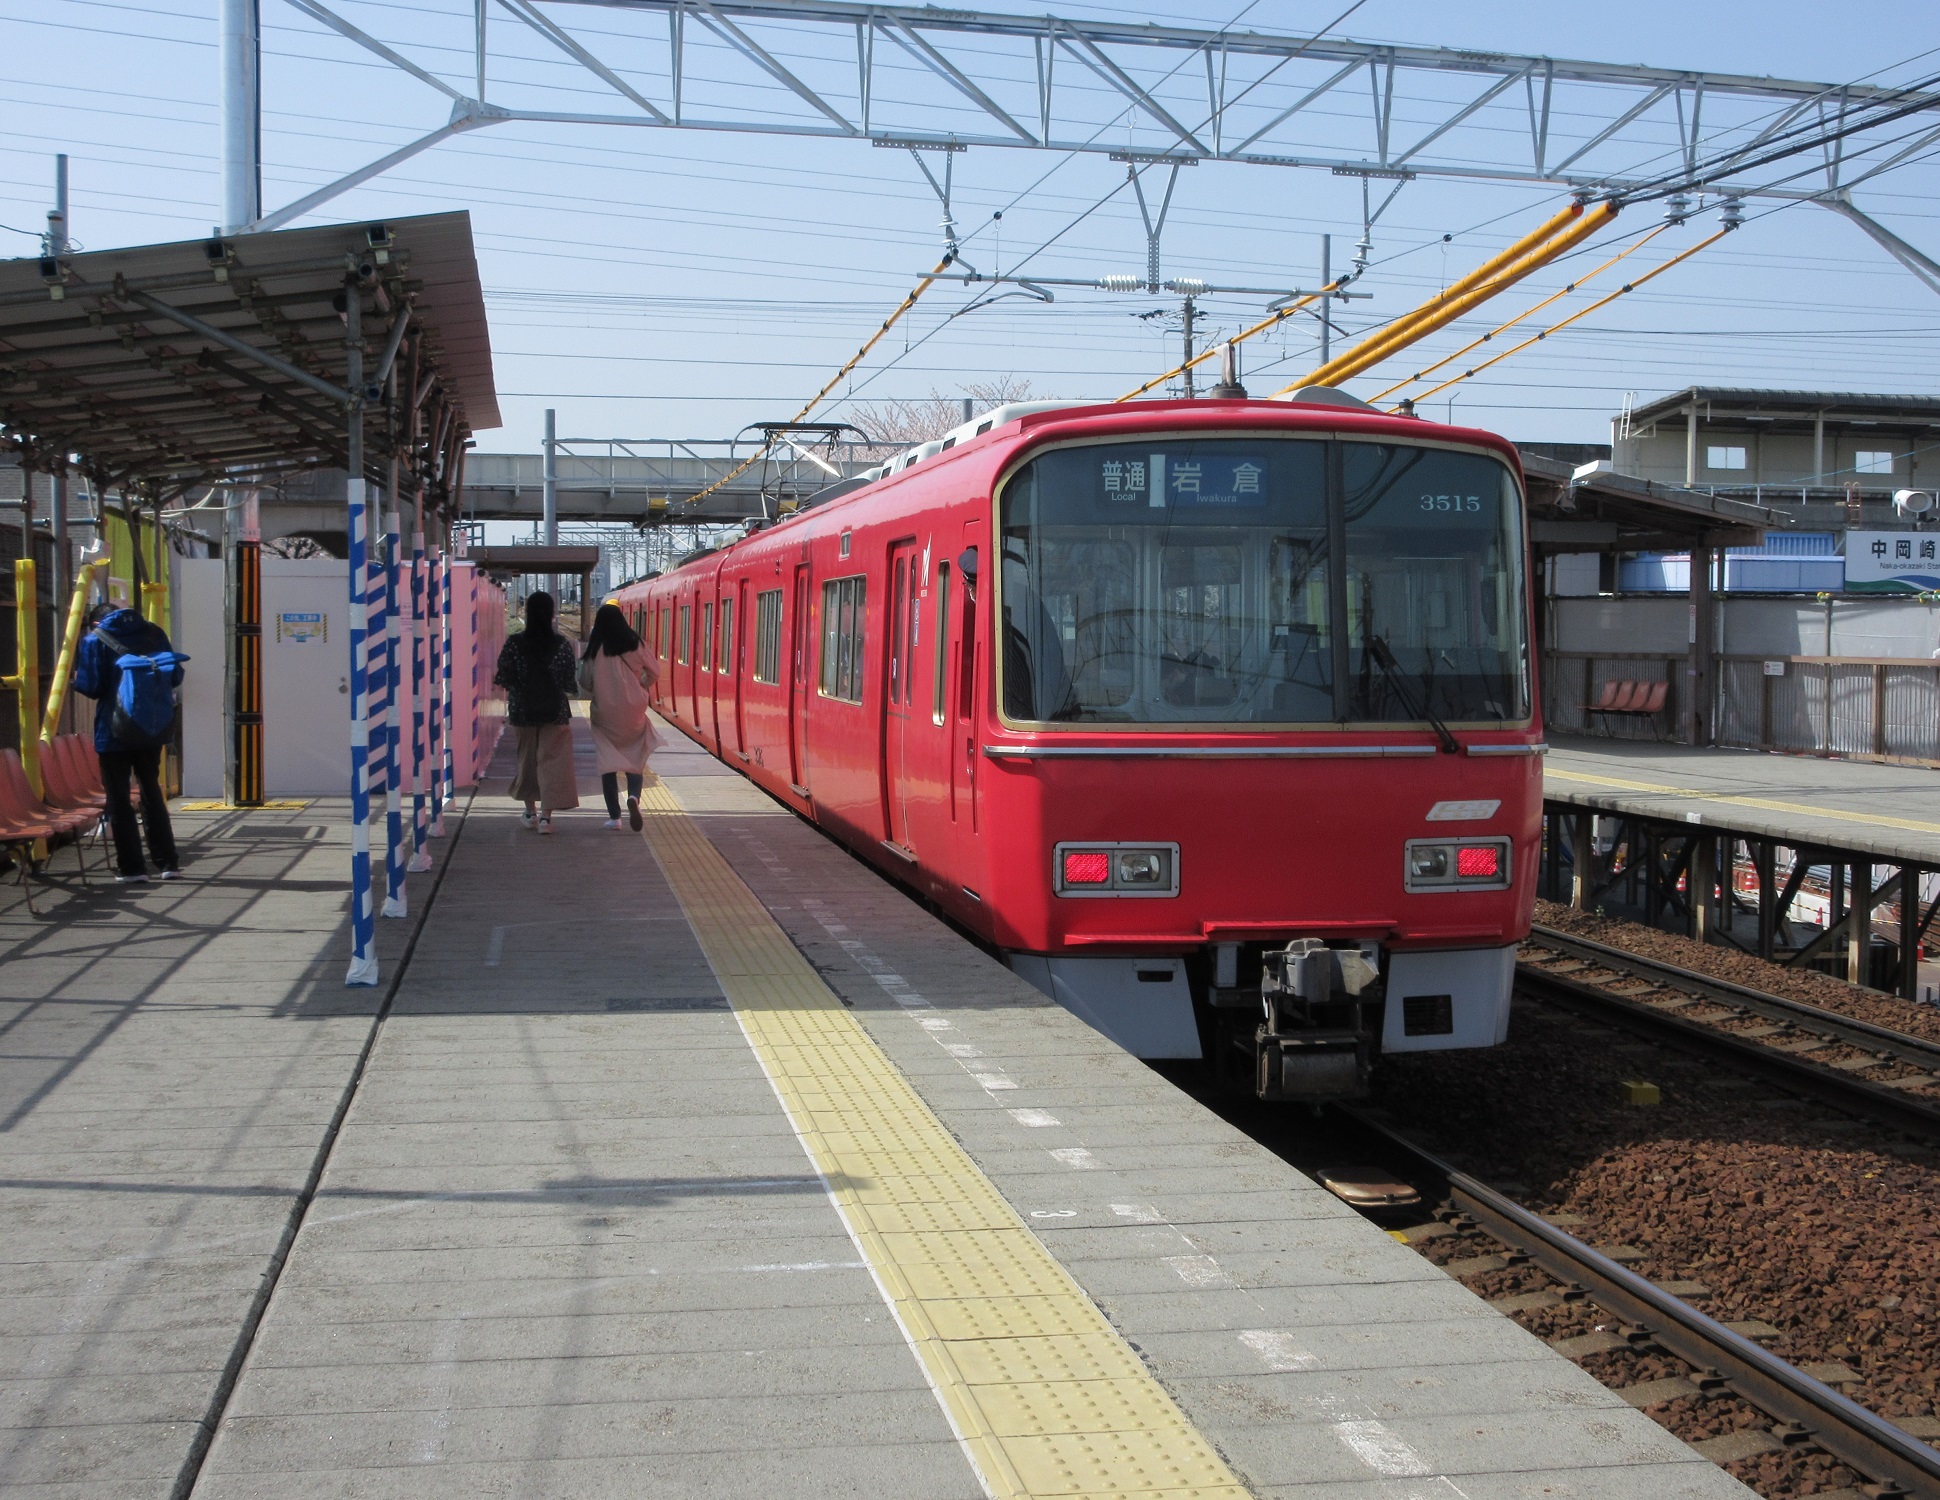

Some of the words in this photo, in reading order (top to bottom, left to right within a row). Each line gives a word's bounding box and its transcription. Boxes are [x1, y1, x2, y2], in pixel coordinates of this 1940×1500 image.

[1102, 460, 1146, 492] 普通
[1171, 460, 1262, 493] 岩倉
[1111, 492, 1136, 501] Local
[1196, 494, 1237, 503] Iwakura
[1420, 494, 1481, 512] 3515
[1871, 539, 1936, 560] 中岡崎
[1880, 562, 1926, 570] Naka-okazaki
